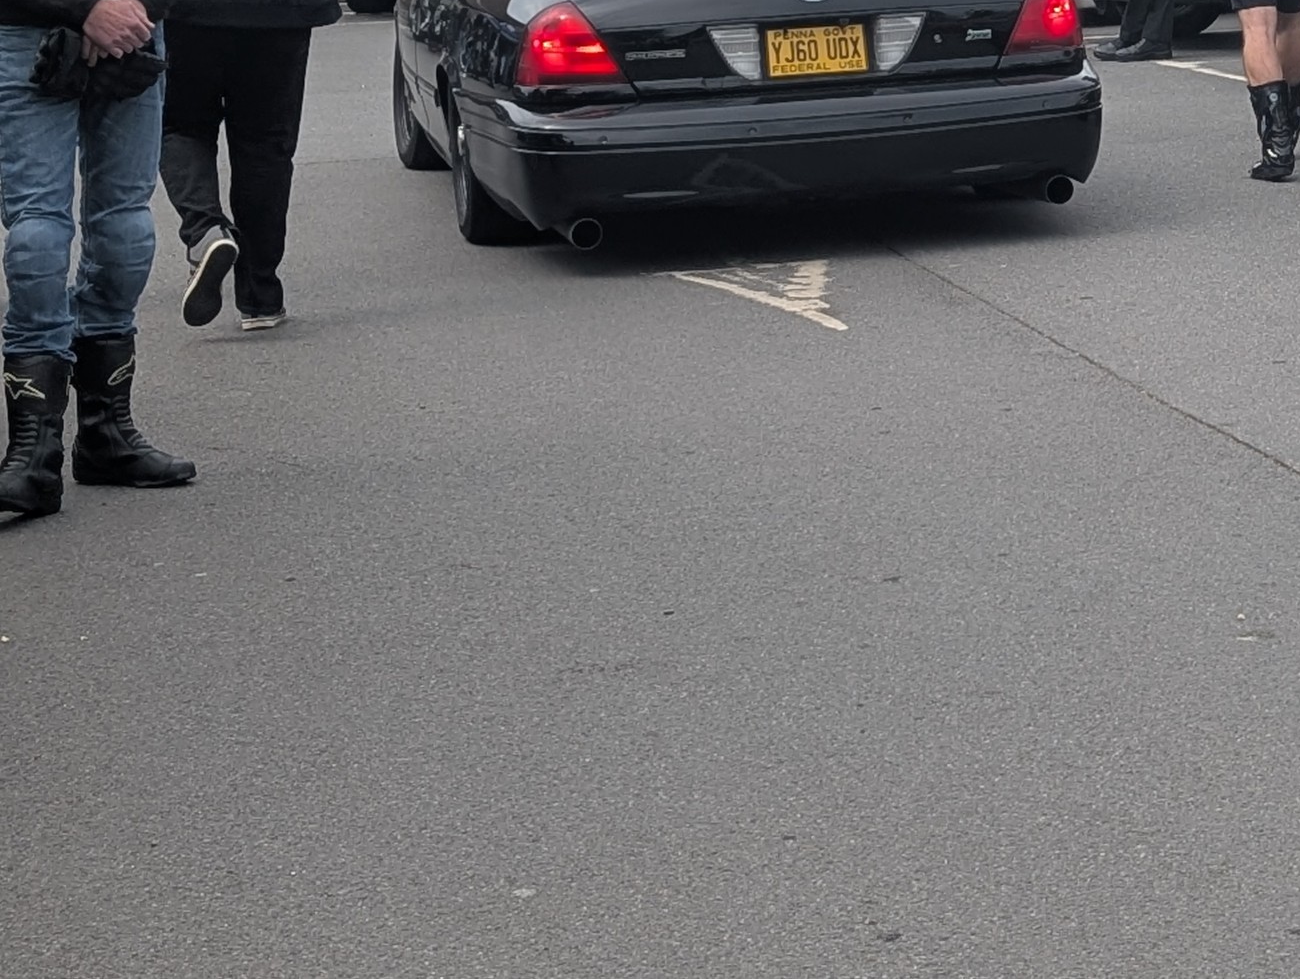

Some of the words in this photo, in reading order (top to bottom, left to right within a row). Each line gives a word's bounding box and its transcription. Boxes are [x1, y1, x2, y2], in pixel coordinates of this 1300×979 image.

[773, 29, 816, 40] PENNA
[771, 39, 819, 64] YJ60
[826, 36, 861, 61] UDX
[771, 62, 831, 74] FEDERAL
[838, 59, 863, 69] USE
